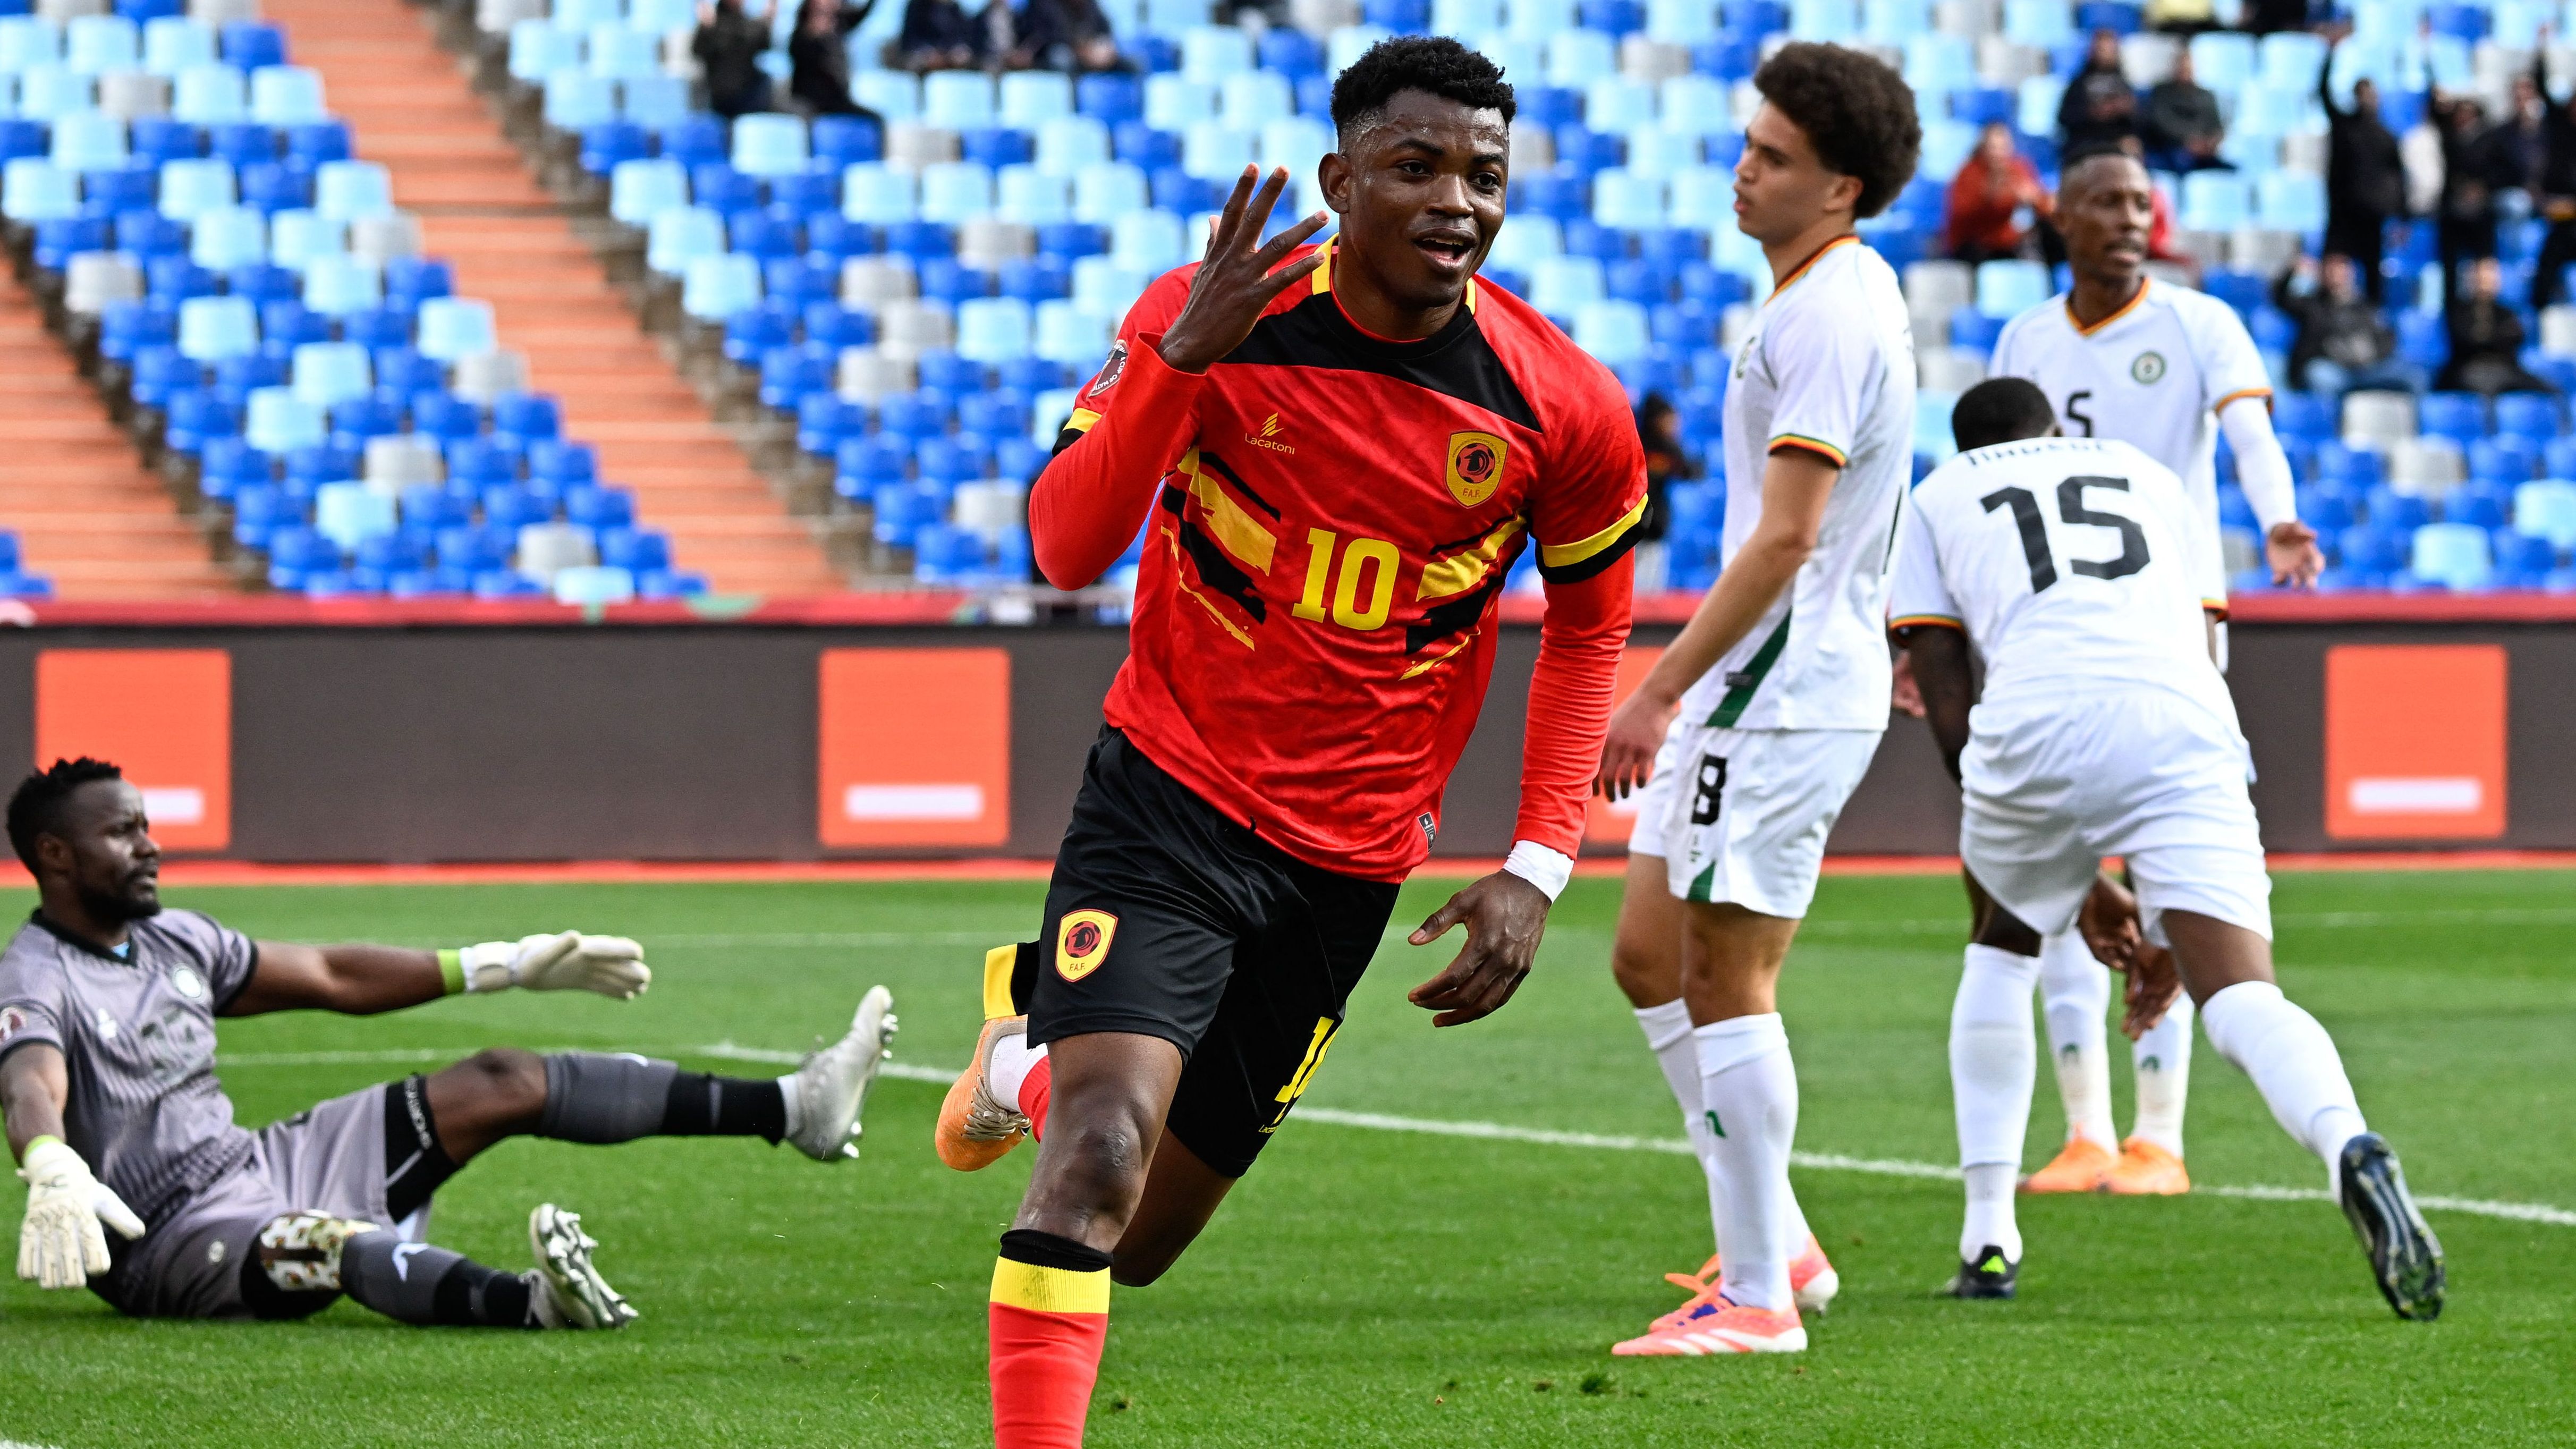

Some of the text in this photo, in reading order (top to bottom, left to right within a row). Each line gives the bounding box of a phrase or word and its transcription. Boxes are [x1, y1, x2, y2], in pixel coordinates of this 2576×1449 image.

[2066, 390, 2092, 437] 5
[1245, 433, 1295, 455] Lacatoni
[1979, 476, 2151, 595] 15
[1291, 527, 1400, 631] 10
[1691, 753, 1728, 825] 8
[1069, 962, 1086, 972] F.A.F.
